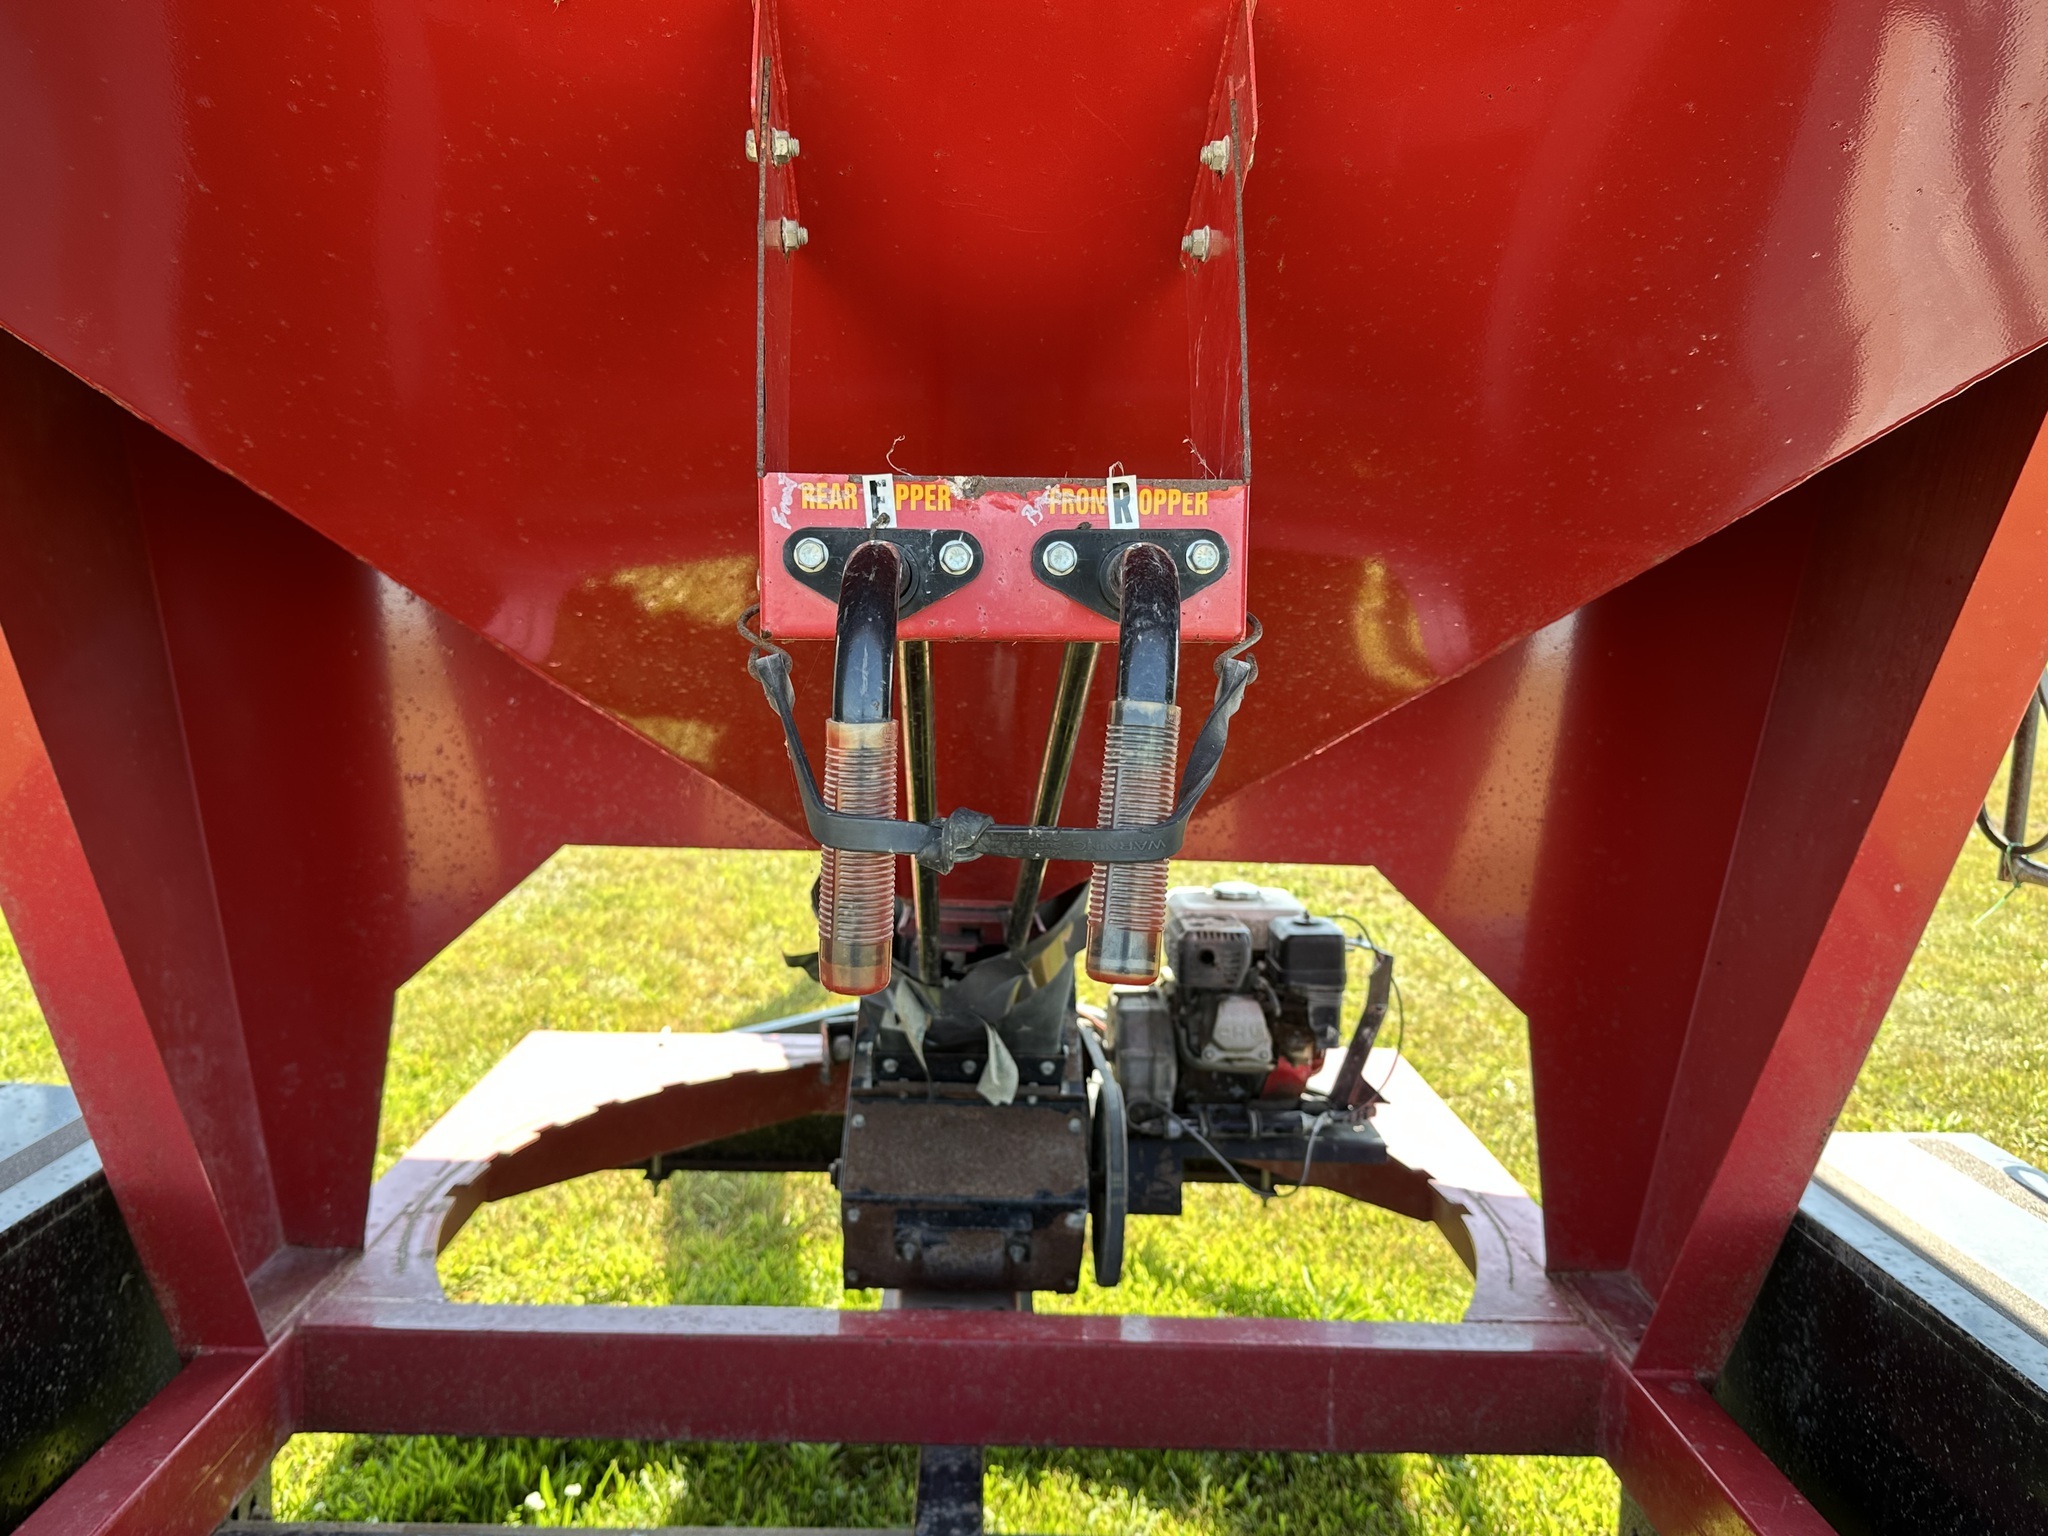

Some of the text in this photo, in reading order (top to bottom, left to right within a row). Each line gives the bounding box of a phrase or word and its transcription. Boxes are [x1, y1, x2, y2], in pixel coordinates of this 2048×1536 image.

[801, 482, 951, 511] REAR PPER
[1049, 487, 1208, 516] FRON OPPER
[1112, 482, 1133, 524] R
